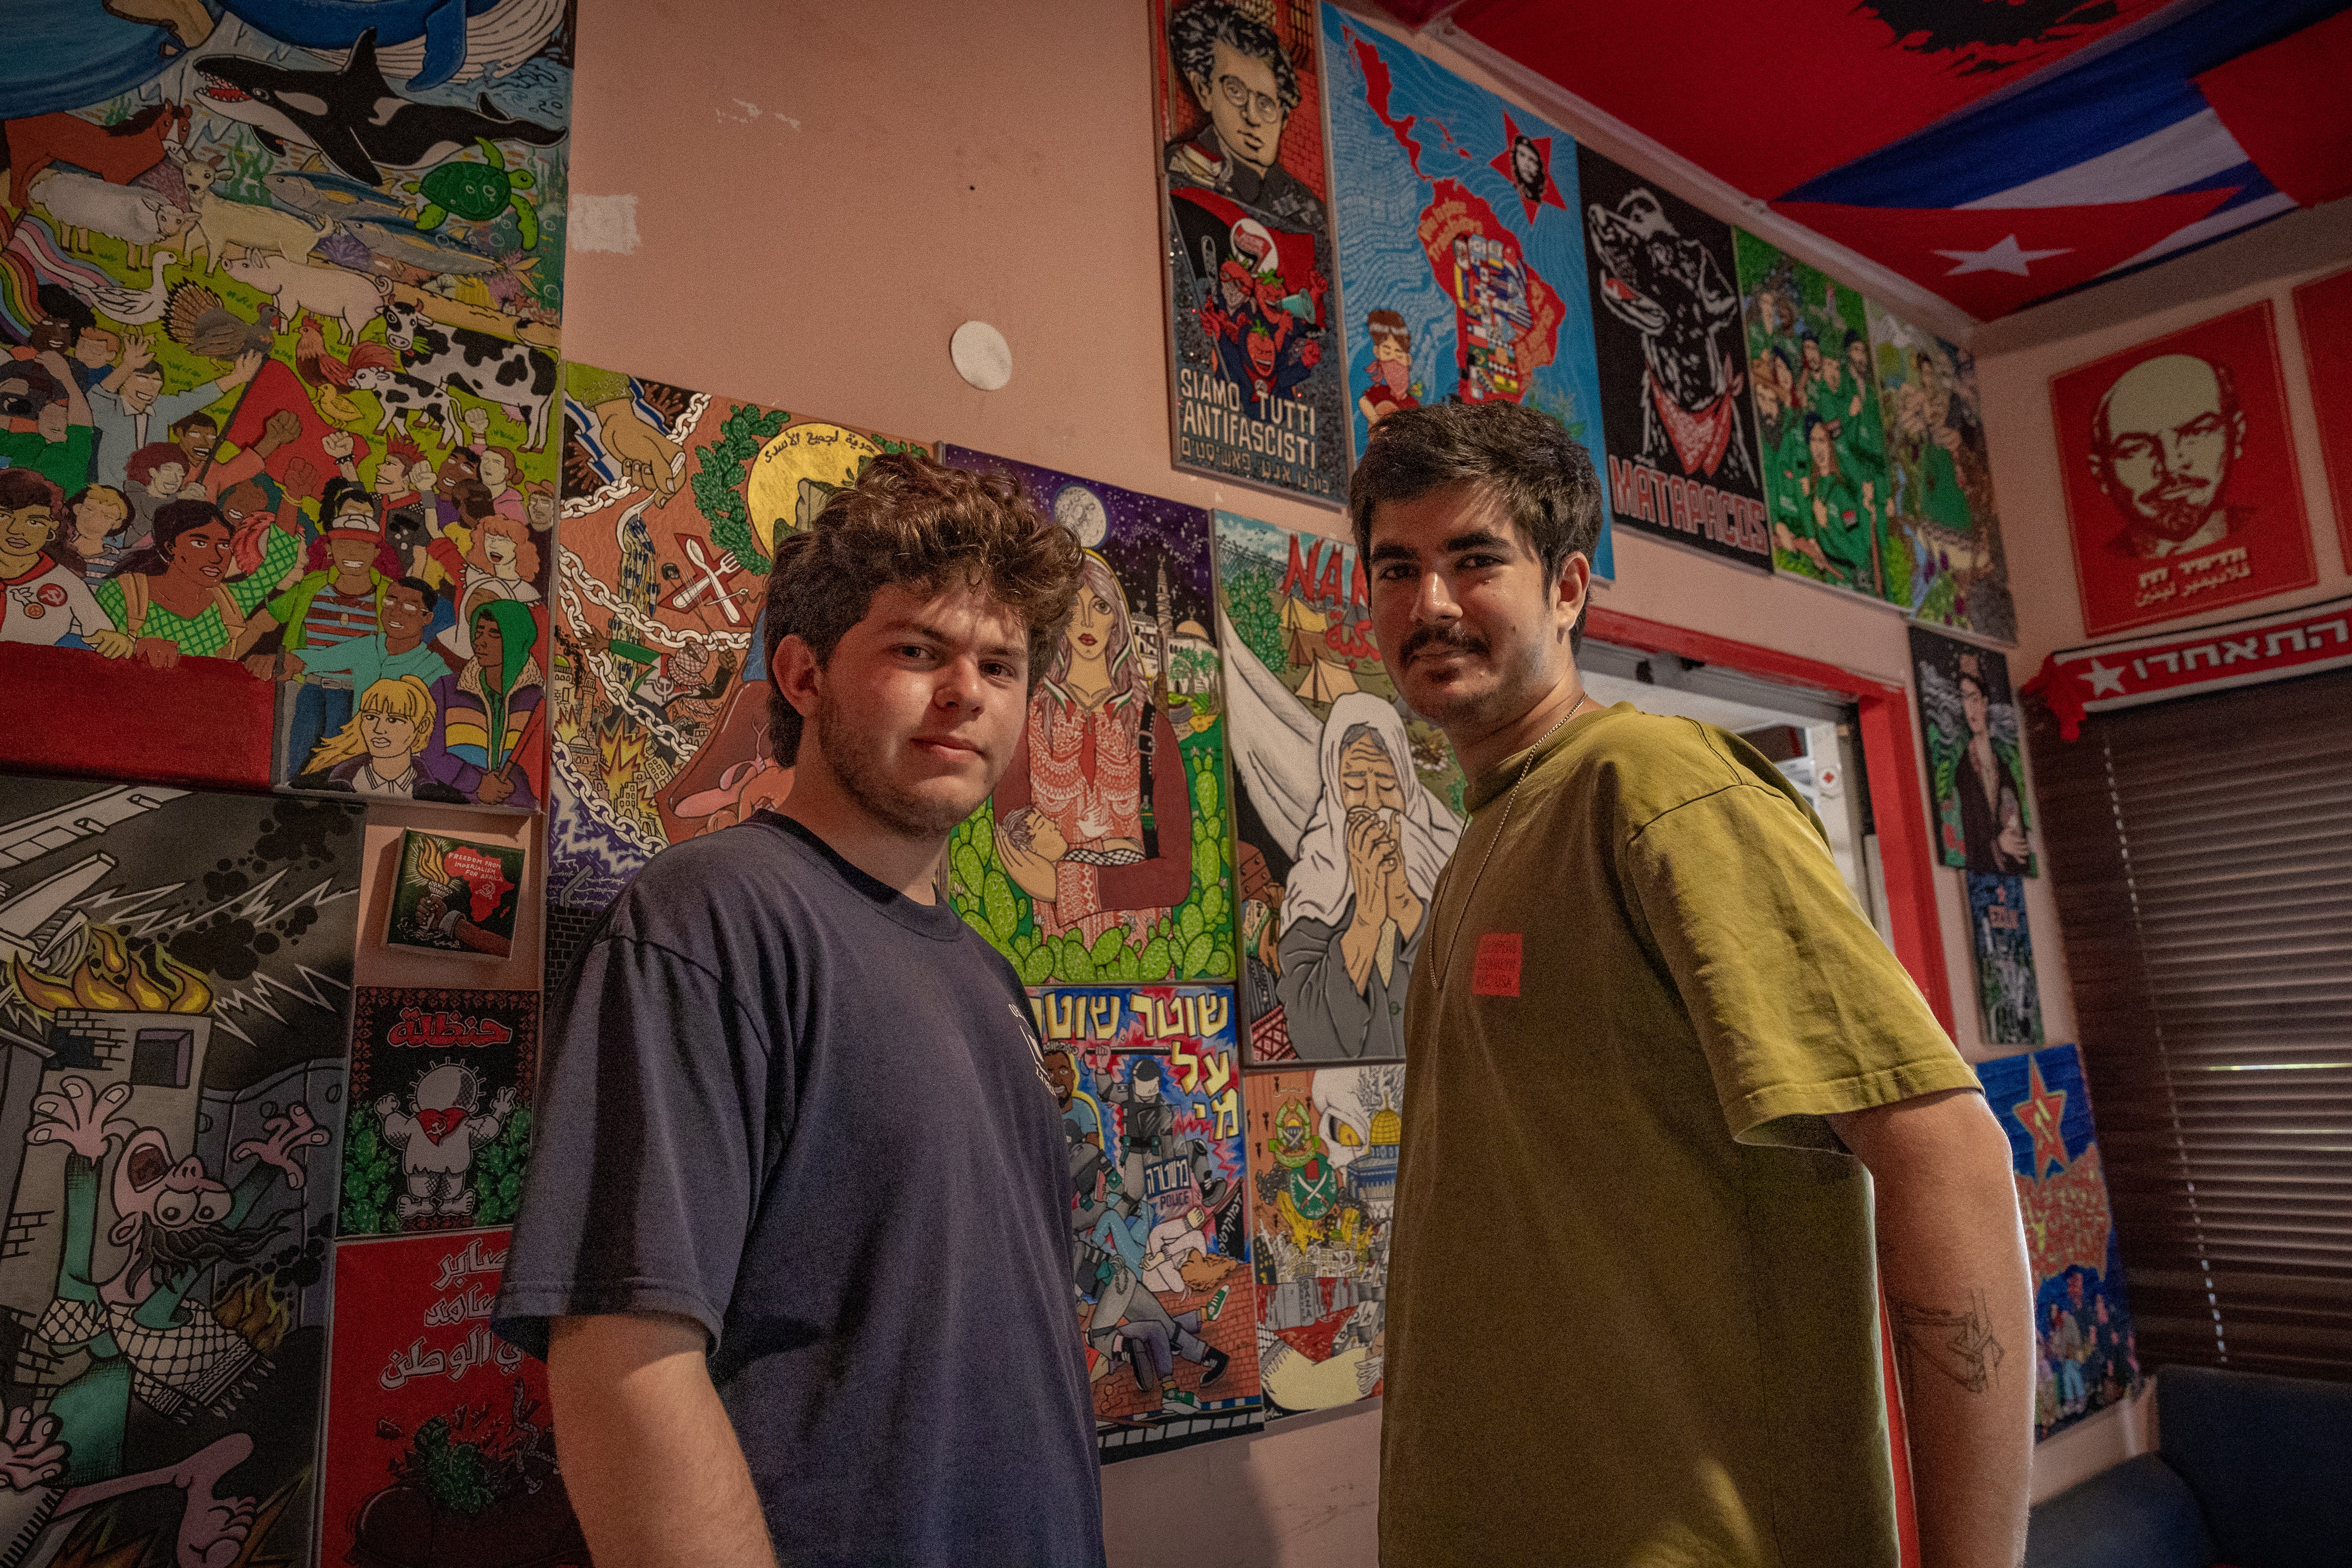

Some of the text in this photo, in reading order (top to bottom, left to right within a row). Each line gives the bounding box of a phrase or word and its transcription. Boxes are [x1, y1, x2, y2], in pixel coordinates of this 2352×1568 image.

[1180, 368, 1316, 437] SIAMO TUTTI
[1182, 399, 1316, 470] ANTIFASCISTI
[1608, 453, 1769, 556] MATAPACOS
[2132, 618, 2349, 681] התאחדו
[448, 852, 501, 869] FREEDOM FROM
[465, 869, 478, 877] FOR
[386, 1006, 513, 1048] حنظلة
[1129, 992, 1230, 1040] שוטר
[1171, 1039, 1231, 1098] על
[1192, 1087, 1240, 1142] מי
[1145, 1158, 1190, 1196] משטרה
[1160, 1191, 1190, 1210] POLICE
[379, 1323, 495, 1392] الوطن
